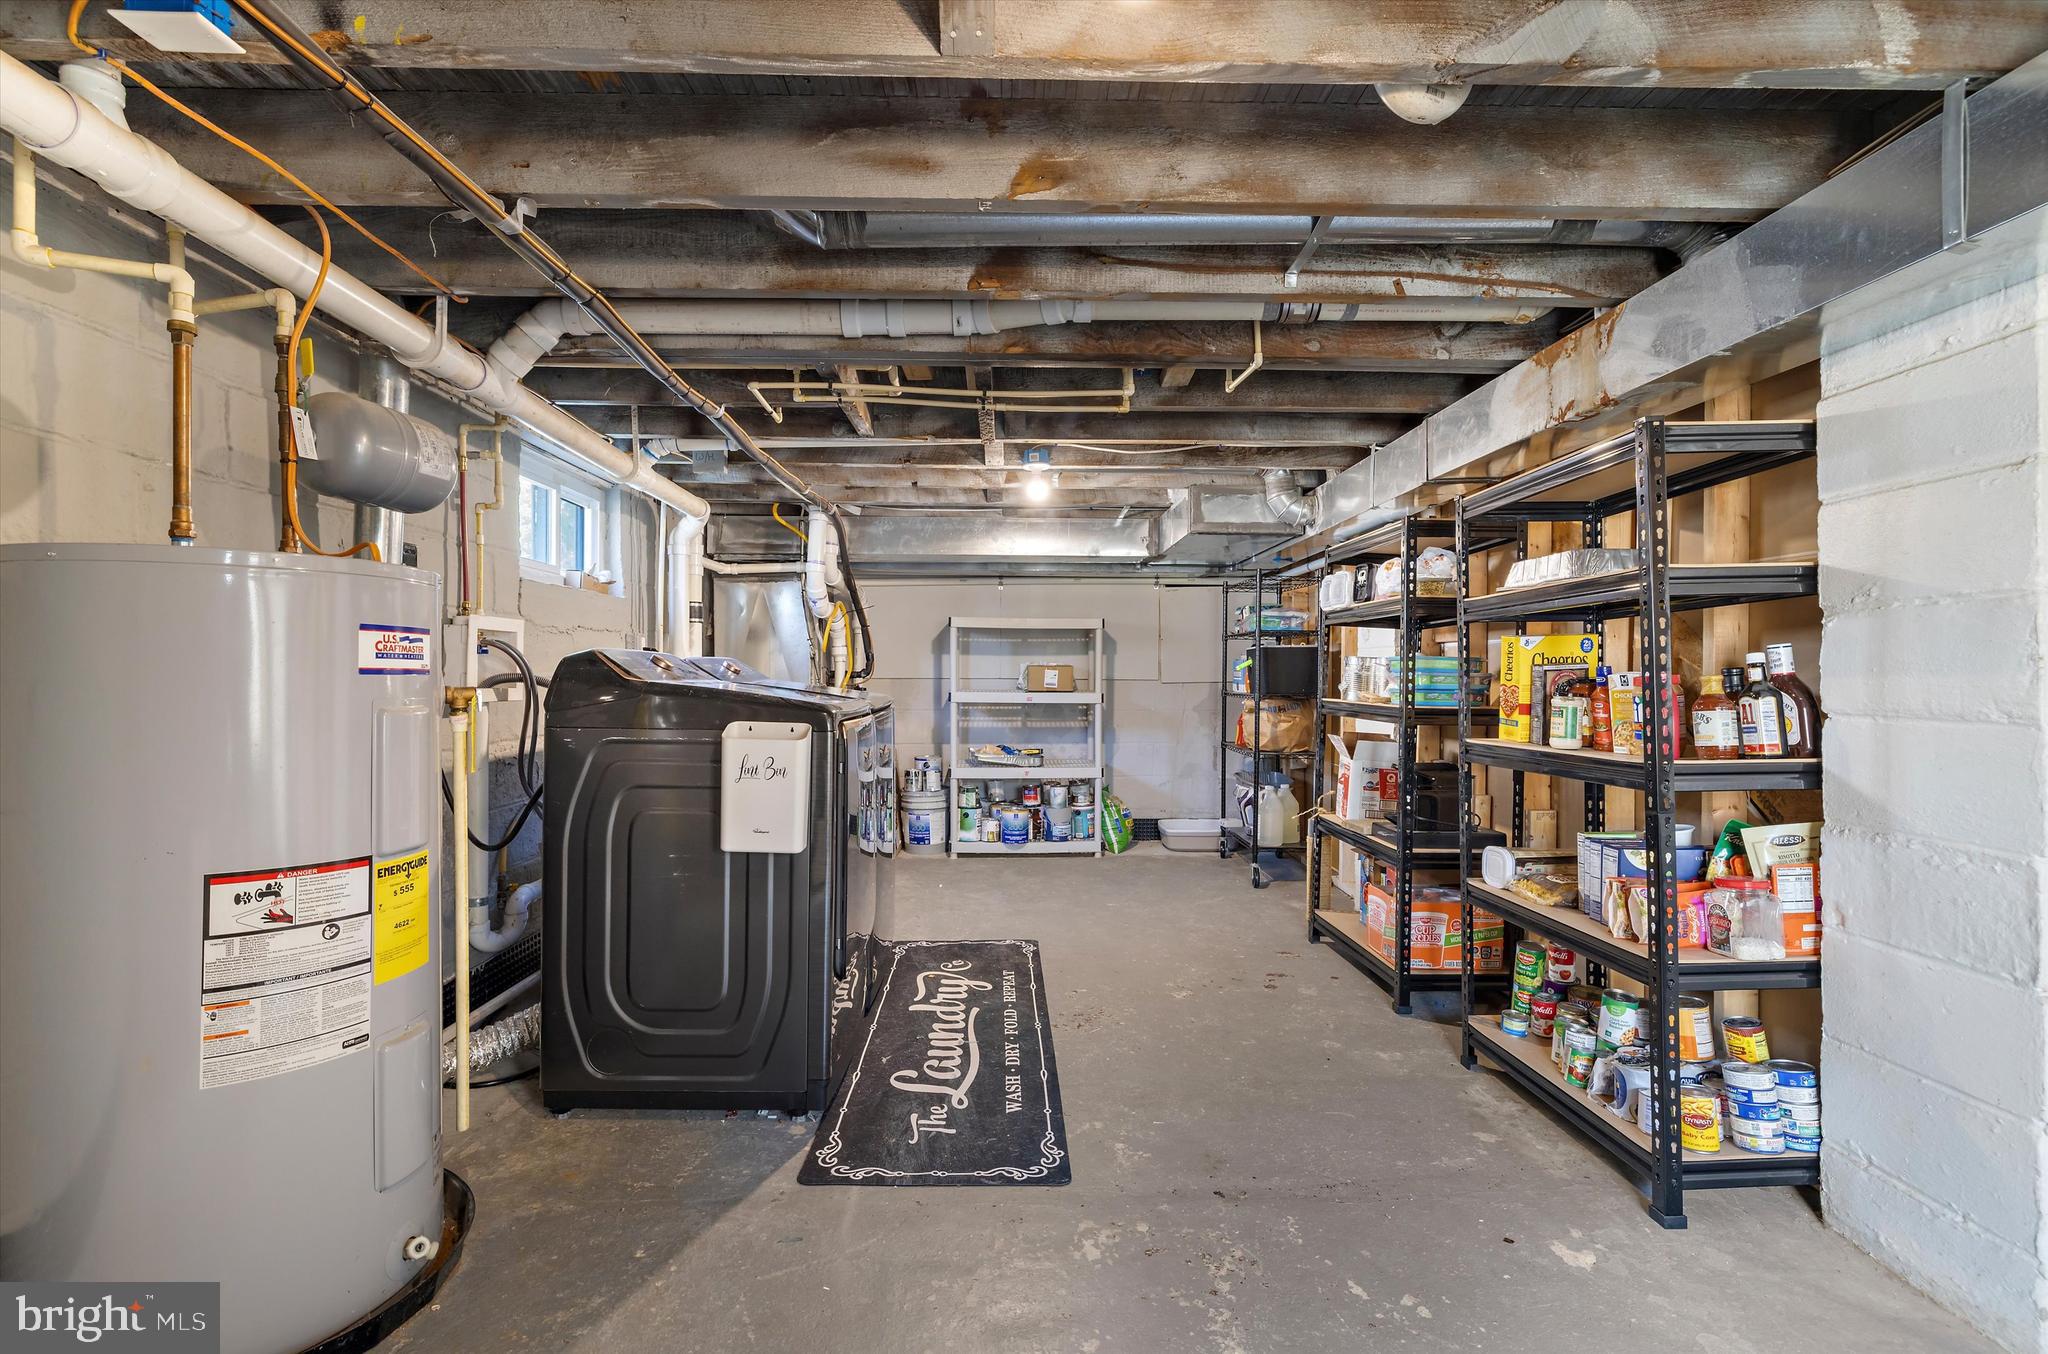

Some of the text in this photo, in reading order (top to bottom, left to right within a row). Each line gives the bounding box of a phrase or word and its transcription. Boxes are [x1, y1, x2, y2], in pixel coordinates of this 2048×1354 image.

[383, 634, 399, 643] U.S.
[375, 641, 424, 653] CRAFTMASTER
[1505, 641, 1514, 681] Cheerios
[764, 757, 787, 780] Bin
[1773, 836, 1801, 846] ALESSI
[287, 868, 318, 878] DANGER
[400, 883, 415, 894] 555
[394, 919, 410, 929] 4622
[1415, 925, 1436, 934] CUP
[1679, 910, 1689, 939] Original
[890, 970, 992, 1109] Laundry
[1002, 970, 1022, 1114] WASH DRY FOLD REPEAT
[909, 1104, 956, 1144] The
[1684, 1116, 1713, 1126] DYNASTY
[1786, 1136, 1812, 1145] StarKist
